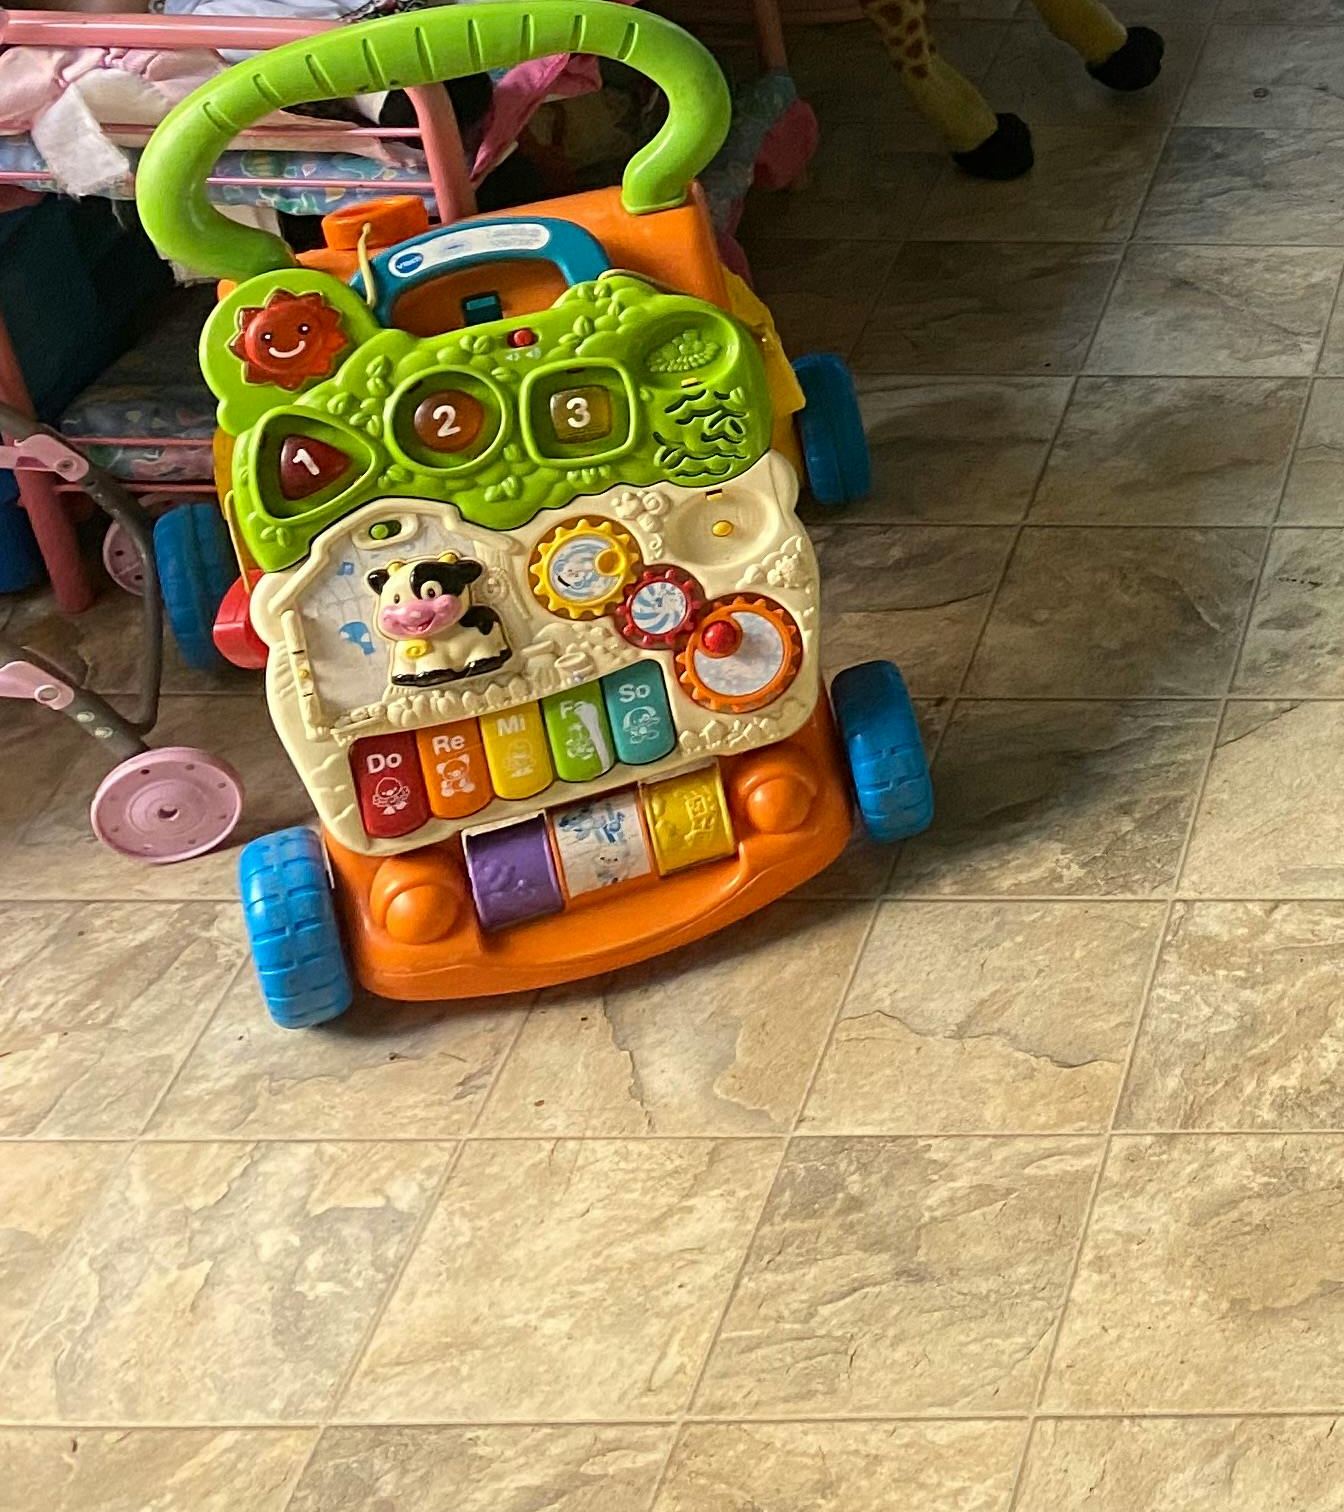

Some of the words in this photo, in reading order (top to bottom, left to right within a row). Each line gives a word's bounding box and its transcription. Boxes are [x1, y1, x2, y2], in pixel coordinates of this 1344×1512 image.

[292, 448, 320, 476] 1
[432, 404, 461, 438] 2
[566, 397, 592, 429] 3
[366, 753, 403, 774] Do
[432, 735, 465, 755] Re
[618, 683, 651, 703] So
